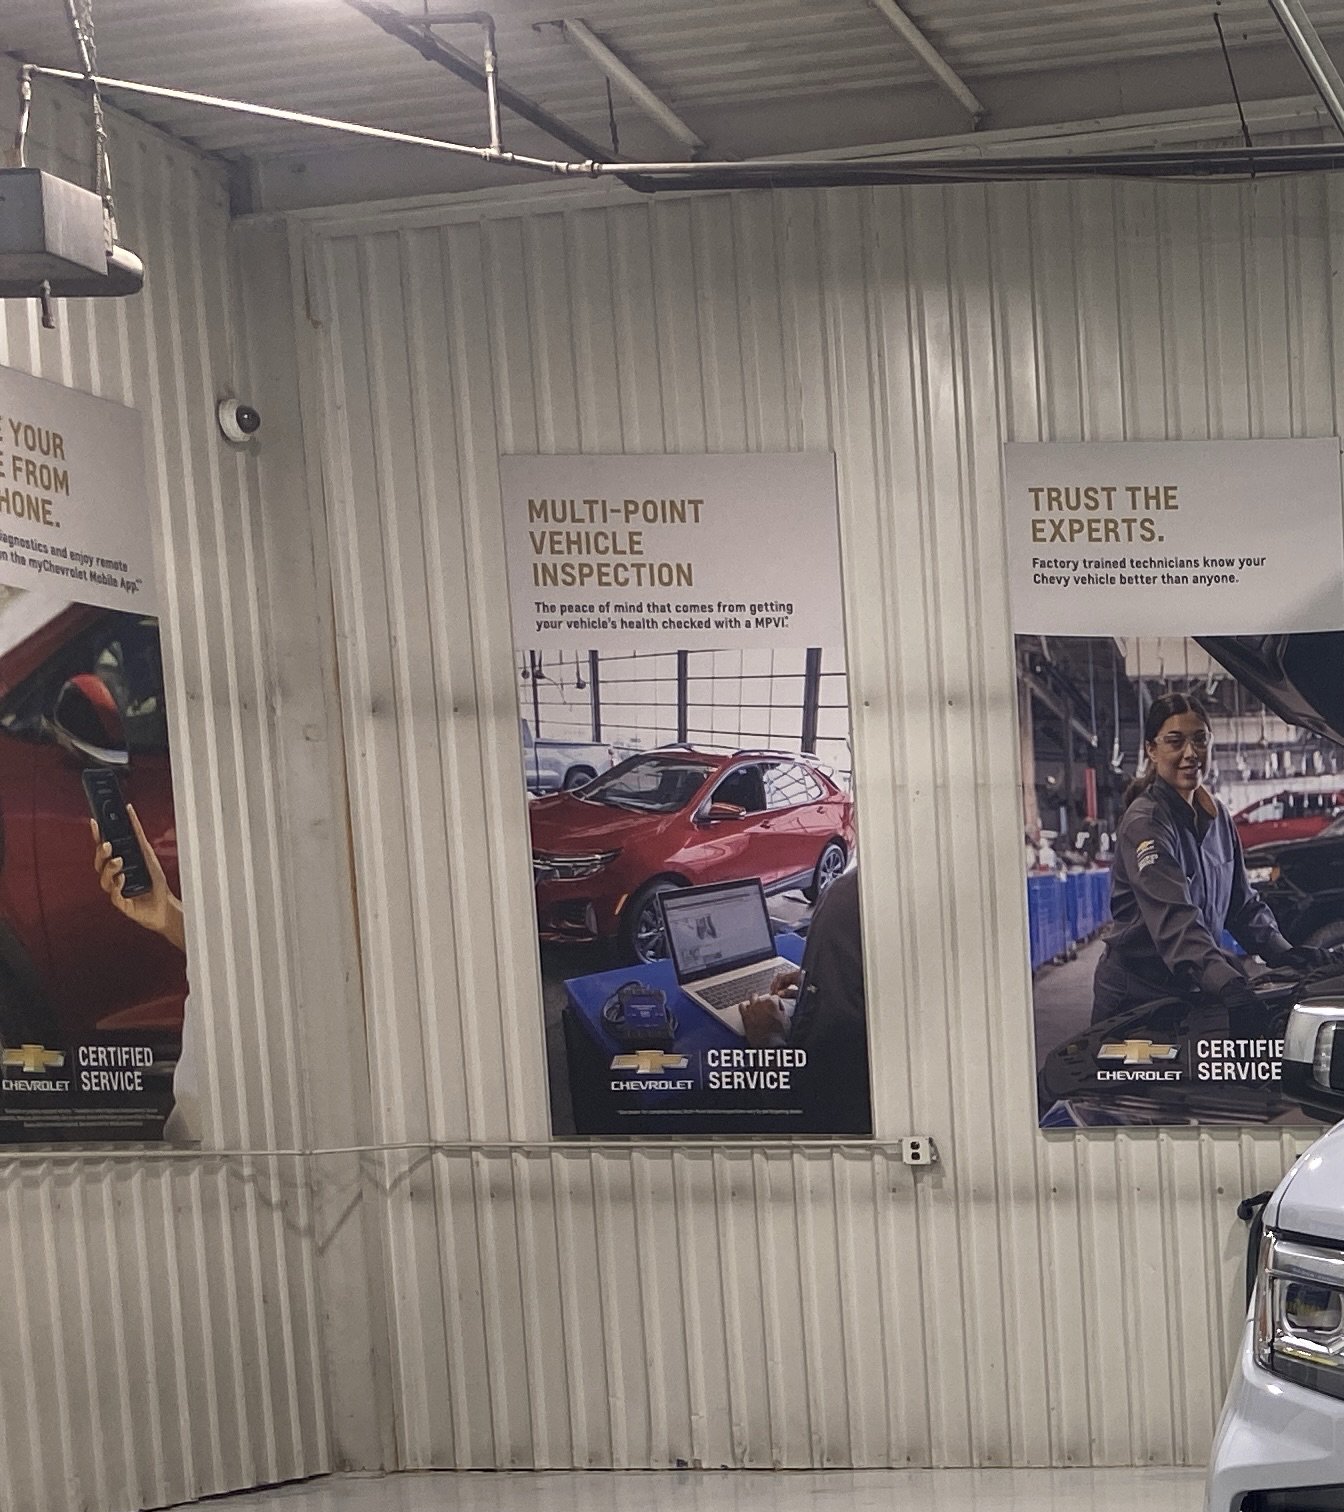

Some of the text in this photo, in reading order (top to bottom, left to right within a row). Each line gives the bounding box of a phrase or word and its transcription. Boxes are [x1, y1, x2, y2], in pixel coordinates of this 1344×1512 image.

[8, 418, 65, 460] YOUR
[12, 455, 69, 496] FROM
[0, 487, 60, 528] HONE.
[1028, 486, 1179, 511] TRUST THE
[528, 499, 704, 524] MULTI-POINT
[1031, 518, 1165, 542] EXPERTS.
[529, 531, 644, 555] VEHICLE
[50, 545, 68, 559] and
[70, 550, 94, 567] enjoy
[95, 556, 129, 572] remote
[1032, 556, 1267, 572] Factory trained technicians know your
[10, 551, 27, 566] the
[28, 558, 88, 581] myChevrolet
[89, 570, 119, 588] Mobile
[532, 562, 693, 587] INSPECTION
[1033, 572, 1240, 587] Chevy vehicle better than anyone.
[534, 601, 794, 616] The peace of mind that comes from getting
[535, 620, 563, 632] your
[566, 617, 618, 629] vehicle's
[620, 617, 659, 629] health
[661, 617, 712, 629] checked
[714, 616, 742, 629] with
[744, 619, 752, 629] a
[78, 1046, 154, 1067] CERTIFIED
[707, 1049, 807, 1067] CERTIFIED
[1197, 1039, 1285, 1058] CERTIFIE
[708, 1071, 791, 1089] SERVICE
[1097, 1070, 1182, 1081] CHEVROLET
[1198, 1061, 1283, 1080] SERVICE
[2, 1079, 70, 1092] CHEVROLET
[80, 1071, 144, 1091] SERVICE
[611, 1080, 694, 1091] CHEVROLET
